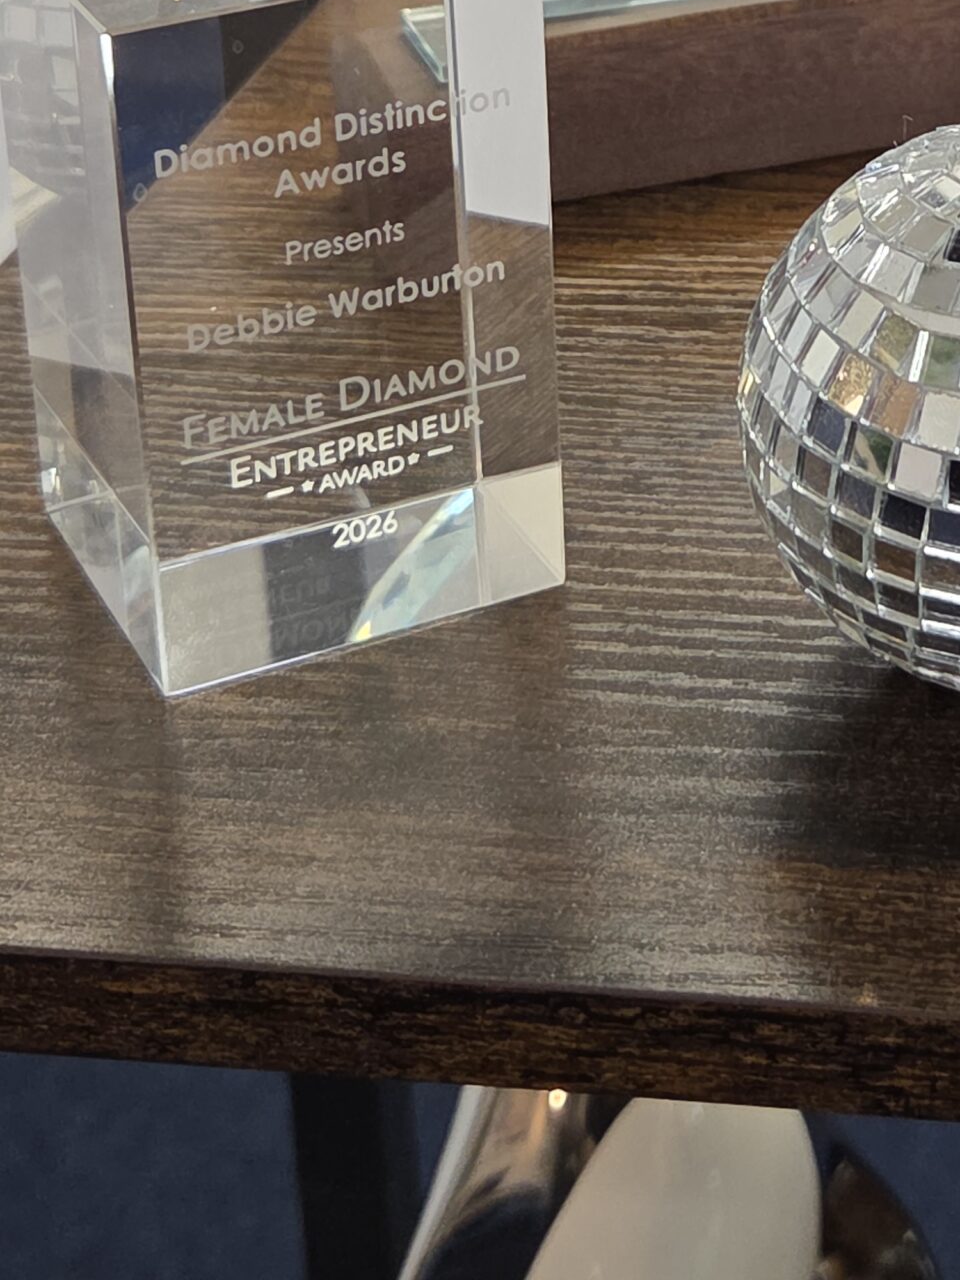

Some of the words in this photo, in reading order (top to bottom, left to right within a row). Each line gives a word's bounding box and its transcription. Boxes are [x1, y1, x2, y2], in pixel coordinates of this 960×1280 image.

[154, 117, 321, 178] Diamond
[274, 148, 407, 199] Awards
[284, 220, 405, 265] Presents
[187, 302, 318, 353] Debbie
[328, 260, 505, 319] Warburton
[182, 392, 324, 450] FEMALE
[339, 346, 520, 412] DIAMOND
[230, 405, 484, 489] ENTREPRENEUR
[319, 455, 405, 494] AWARD
[333, 510, 398, 549] 2026
